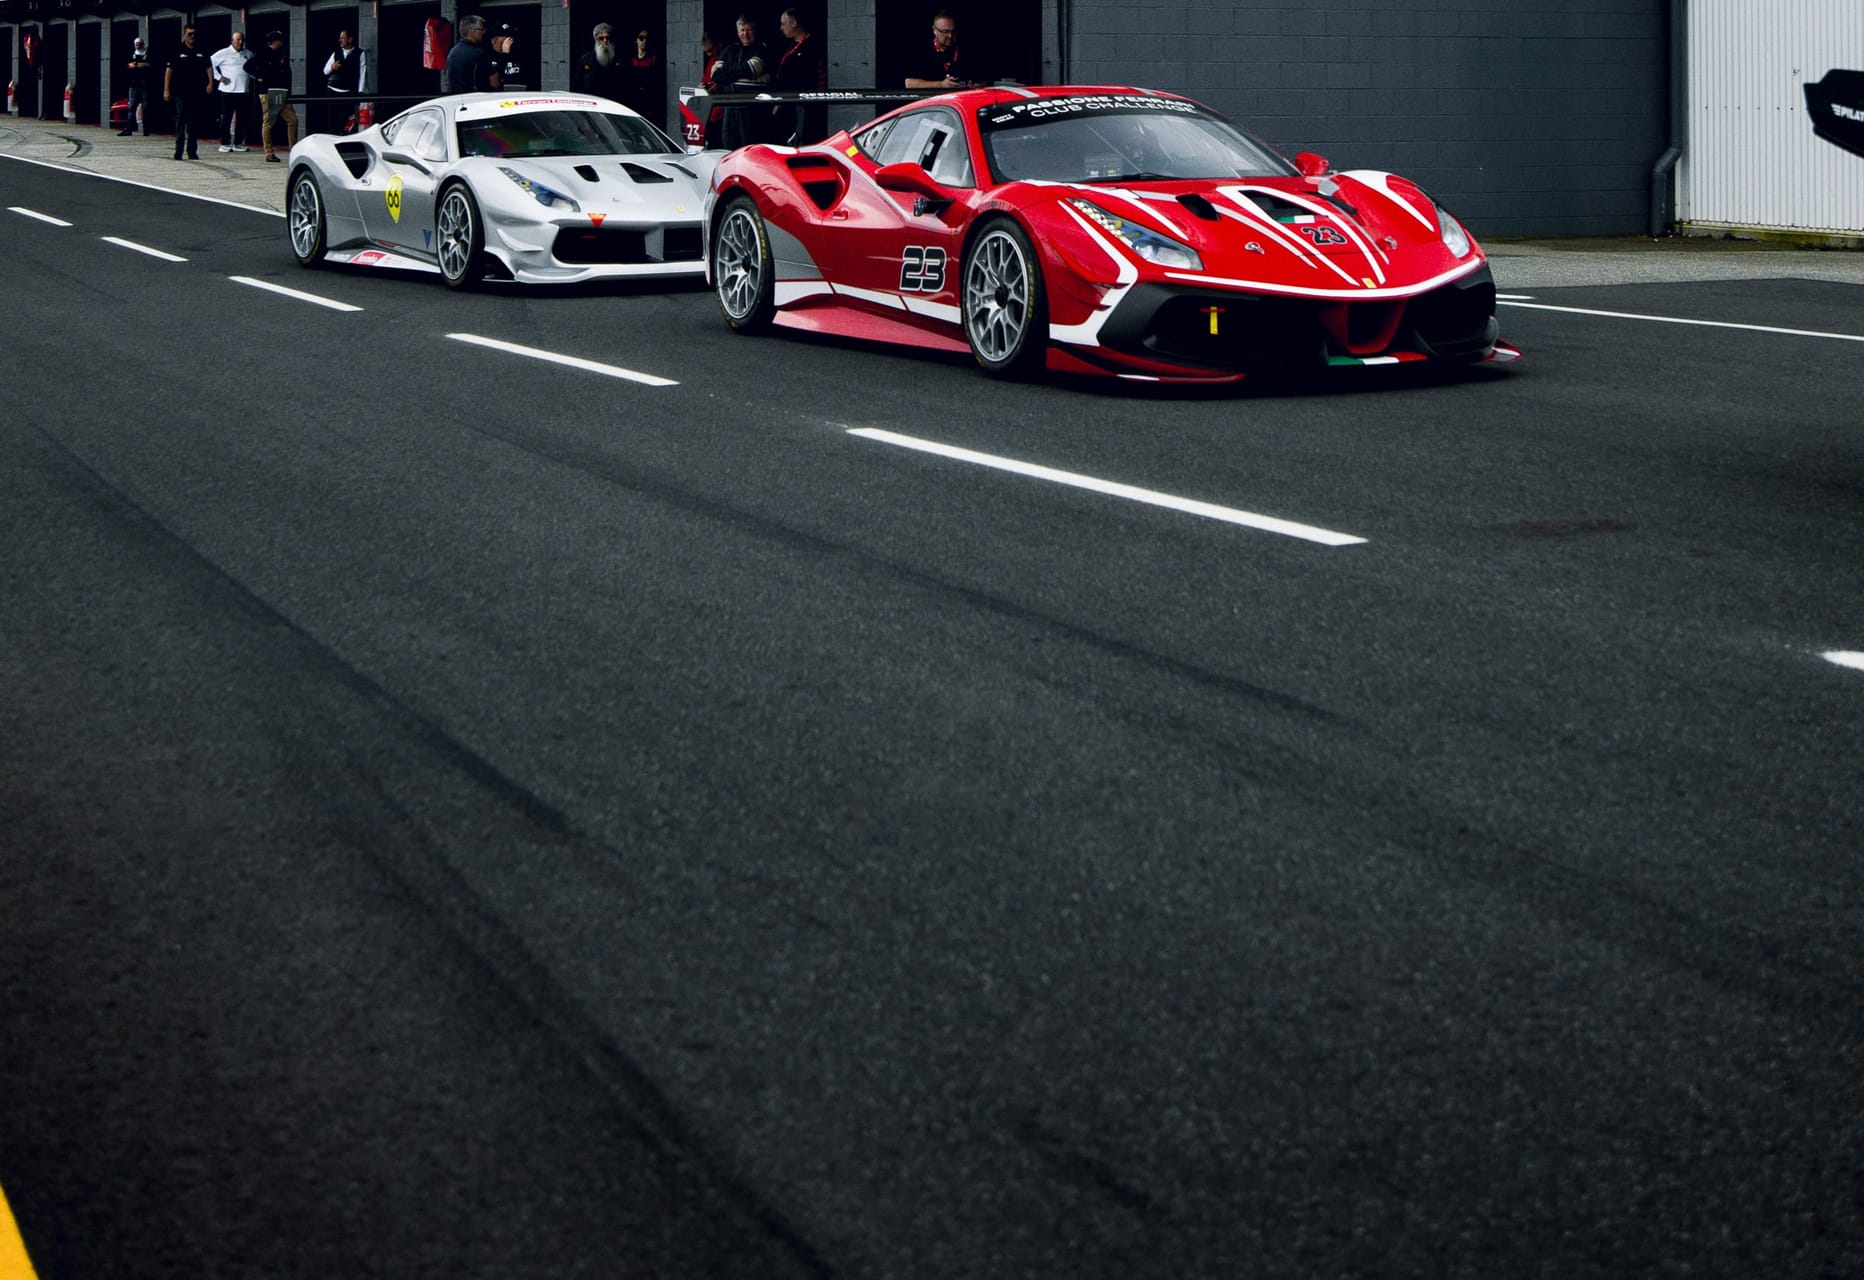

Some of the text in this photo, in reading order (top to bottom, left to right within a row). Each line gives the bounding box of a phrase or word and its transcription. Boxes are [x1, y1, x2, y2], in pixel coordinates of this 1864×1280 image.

[1012, 96, 1195, 113] PASSIONE FERRARI
[1030, 102, 1198, 118] CLUB CHALLENGE
[686, 123, 700, 141] 23
[387, 189, 400, 209] 66
[1301, 227, 1348, 245] 23
[899, 245, 947, 293] 23
